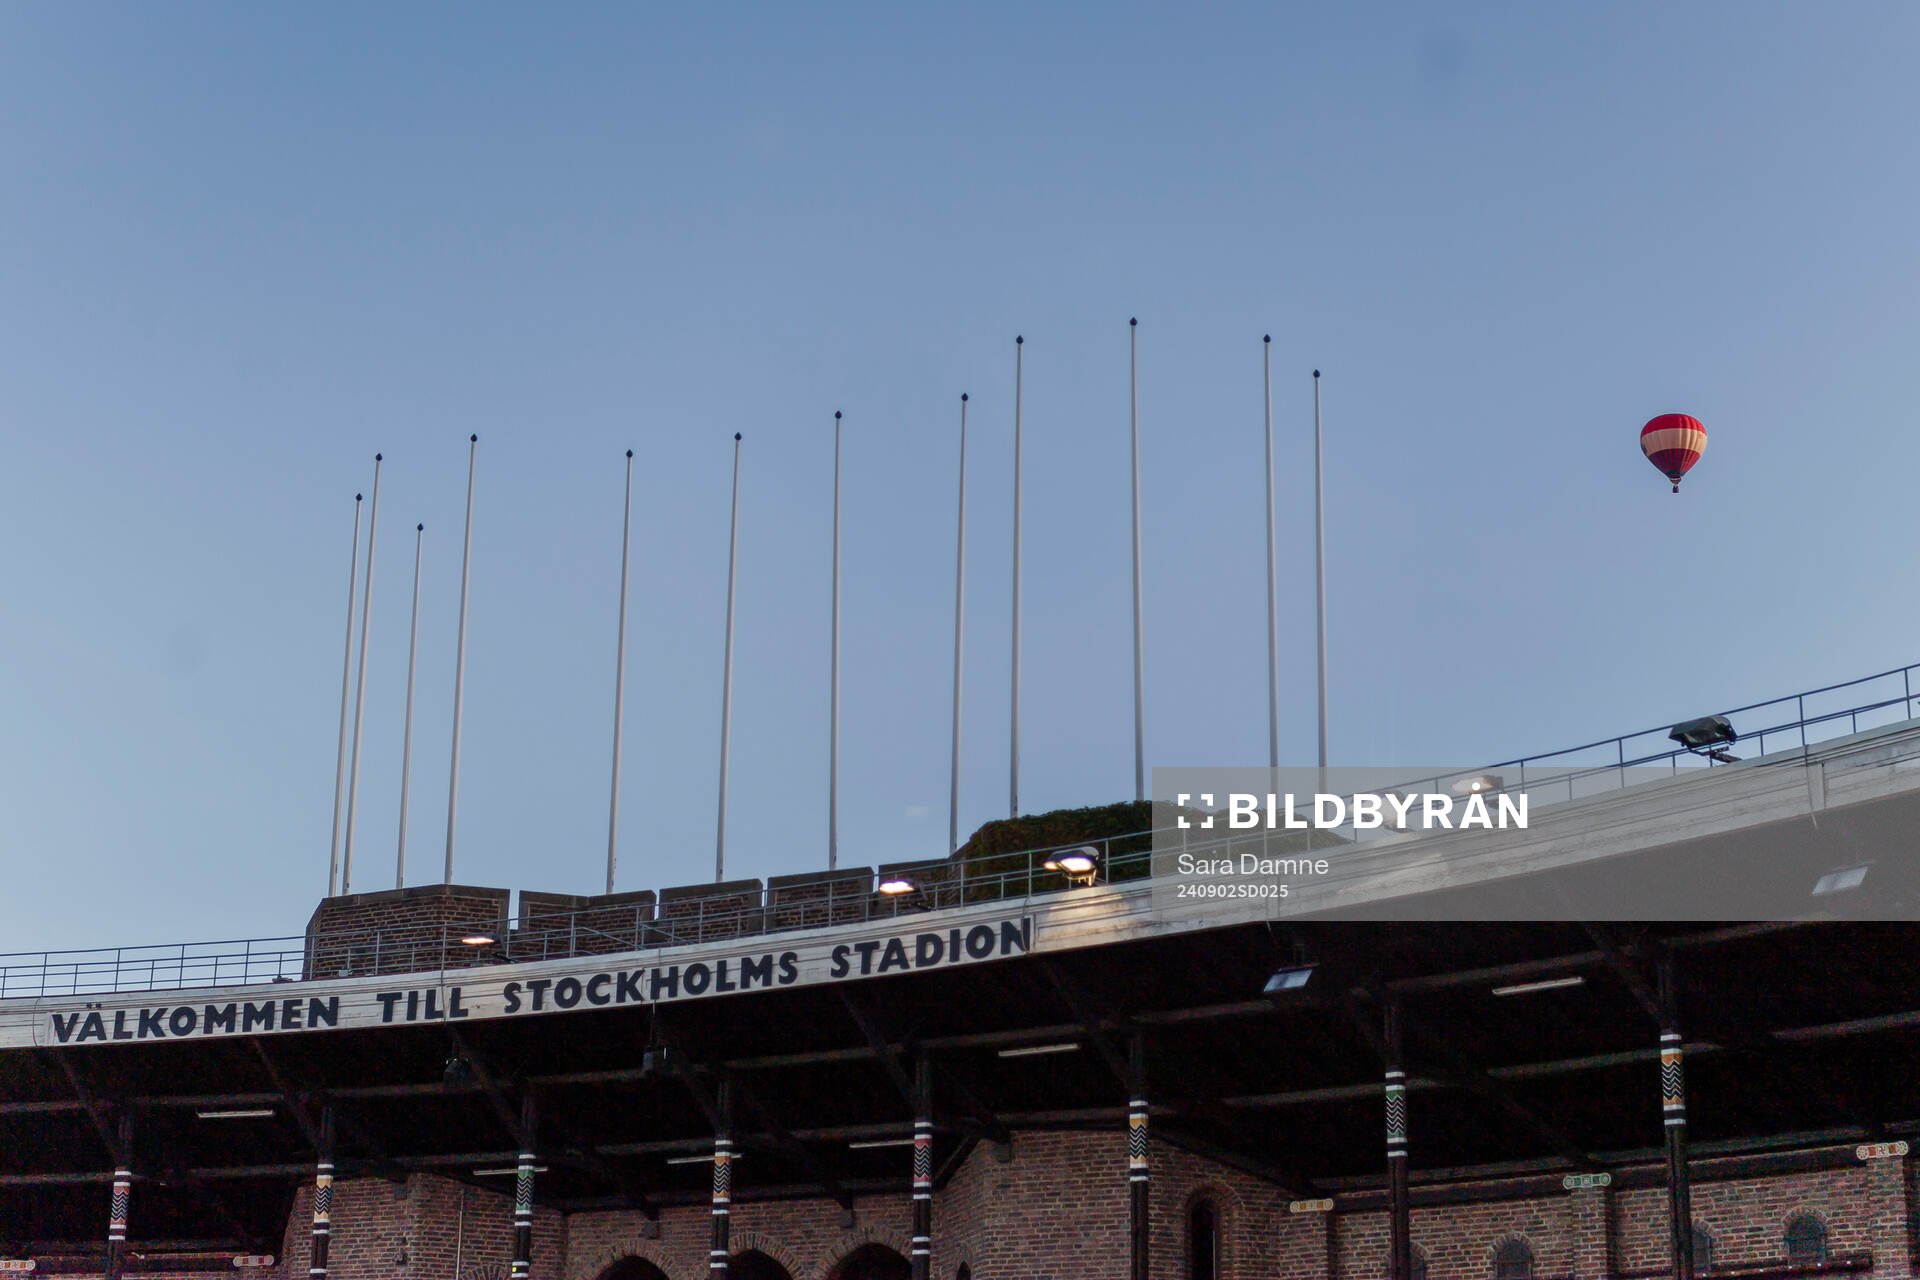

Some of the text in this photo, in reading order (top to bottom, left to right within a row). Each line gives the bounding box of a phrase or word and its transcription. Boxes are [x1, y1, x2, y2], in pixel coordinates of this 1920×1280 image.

[52, 918, 1031, 1043] VÄLKOMMEN TILL STOCKHOLMS STADION
